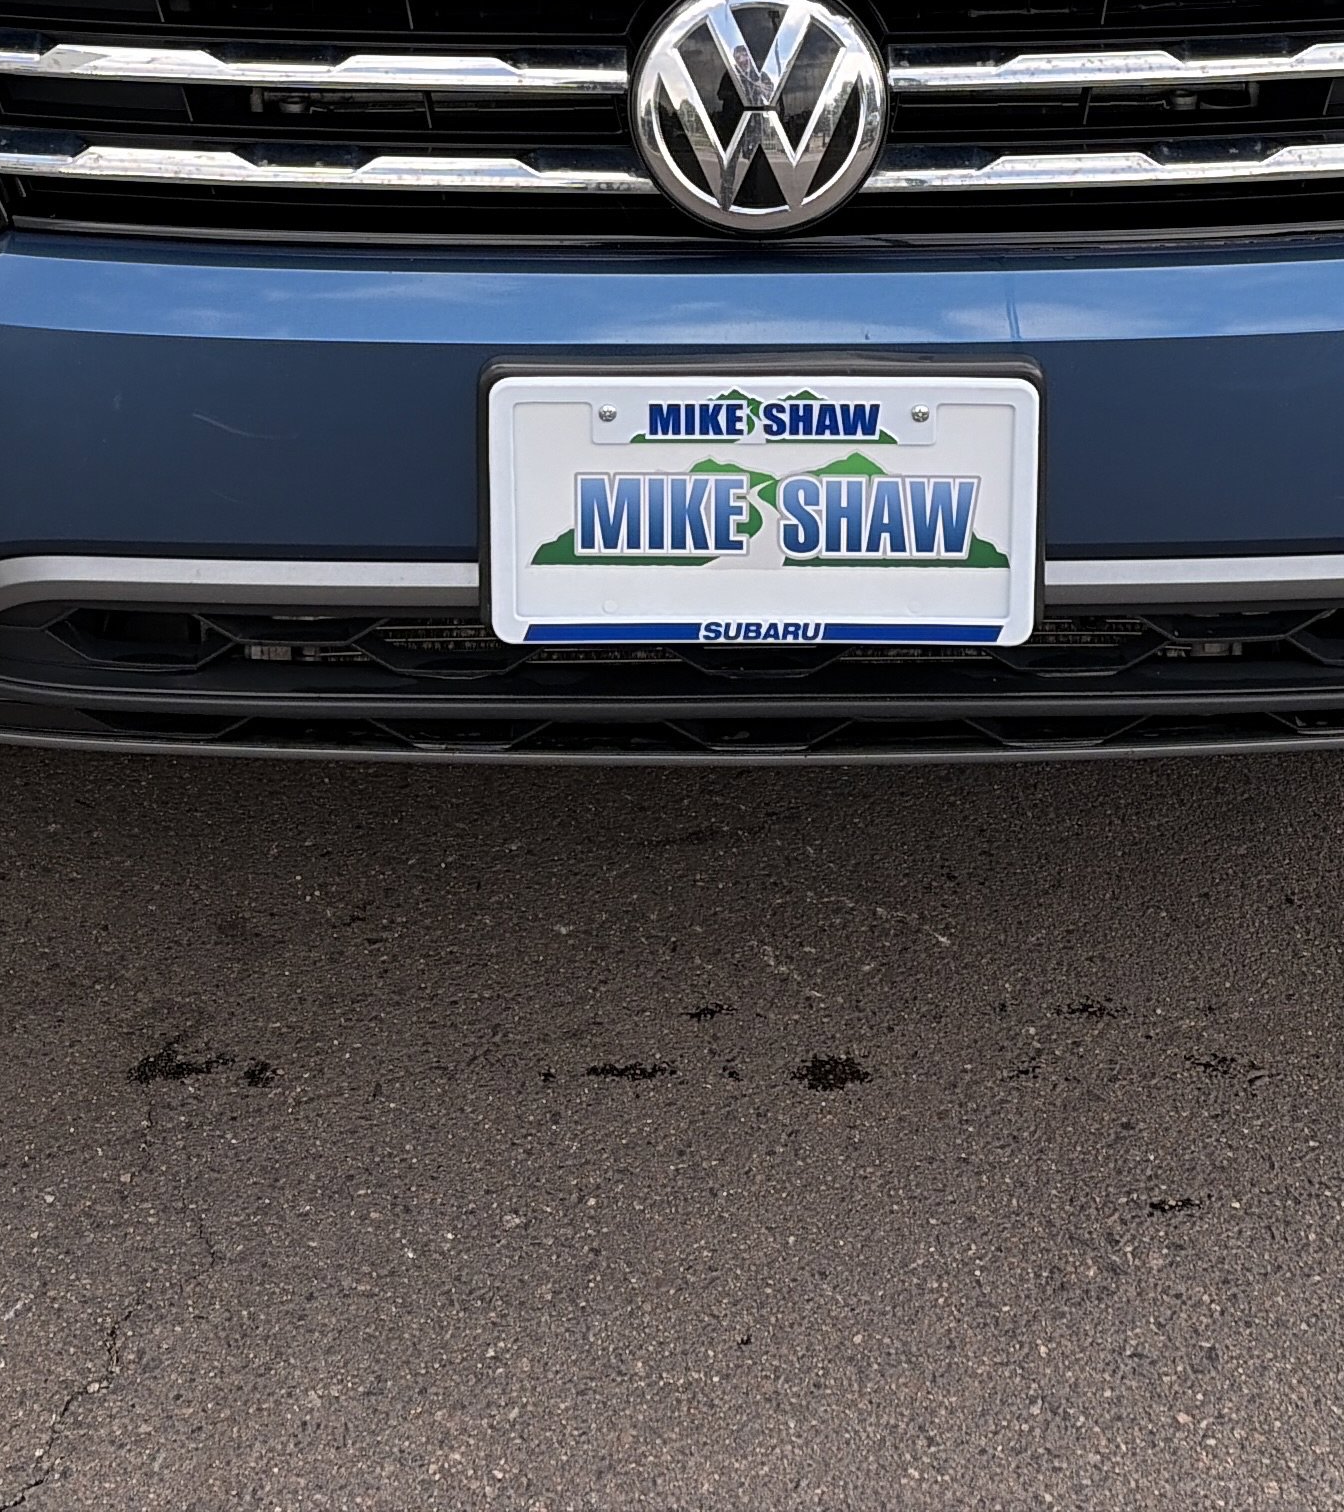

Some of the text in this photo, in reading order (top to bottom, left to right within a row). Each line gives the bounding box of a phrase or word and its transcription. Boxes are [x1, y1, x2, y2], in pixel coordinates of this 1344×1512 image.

[648, 402, 880, 436] MIKE SHAW
[577, 475, 976, 555] MIKE SHAW
[702, 621, 822, 641] SUBARU
